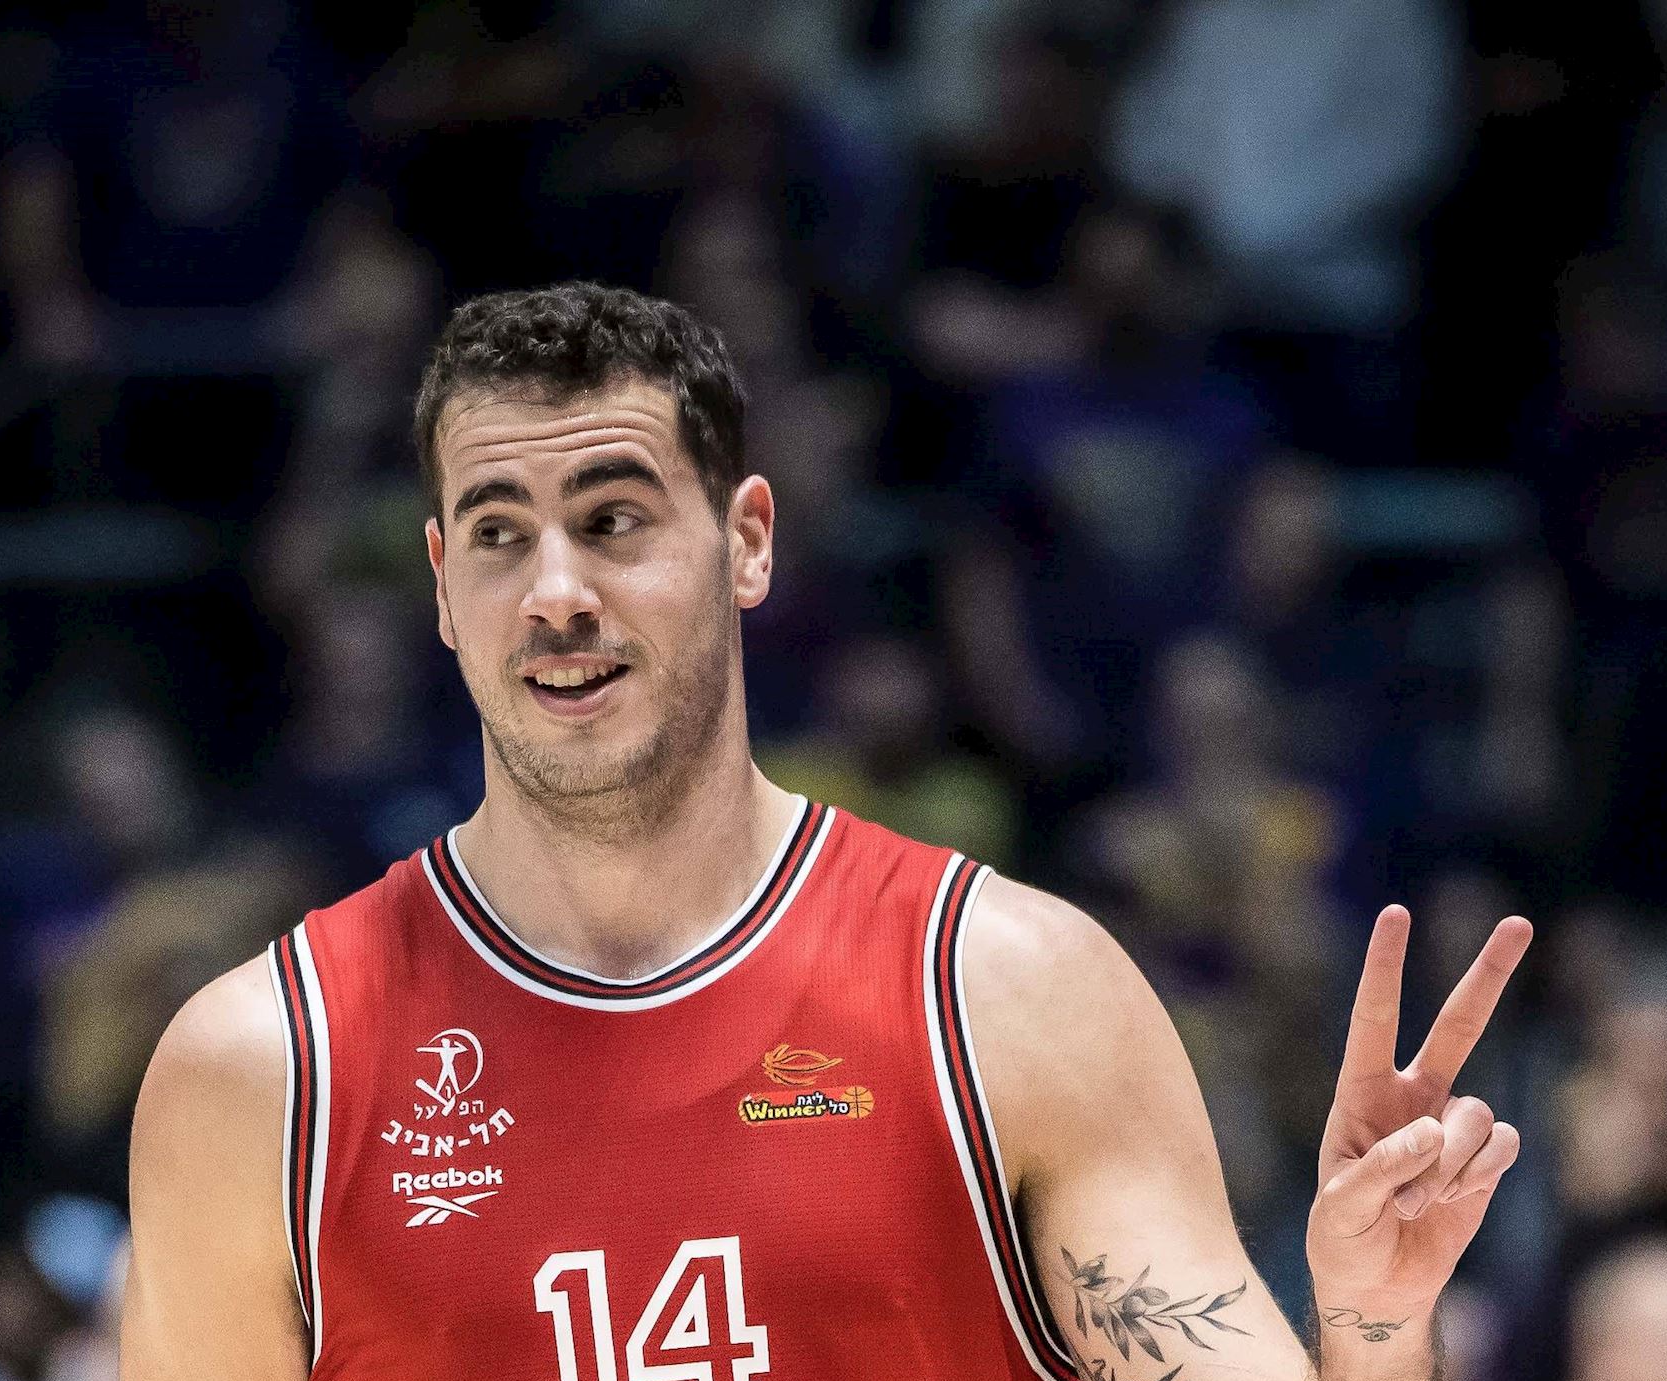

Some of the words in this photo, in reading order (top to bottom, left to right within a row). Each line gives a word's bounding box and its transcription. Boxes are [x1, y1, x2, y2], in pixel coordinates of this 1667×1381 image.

[797, 1091, 824, 1106] ליגת
[828, 1100, 849, 1114] סל
[745, 1102, 827, 1121] Winner
[380, 1107, 516, 1158] תל-אביב
[392, 1165, 503, 1196] Reebok
